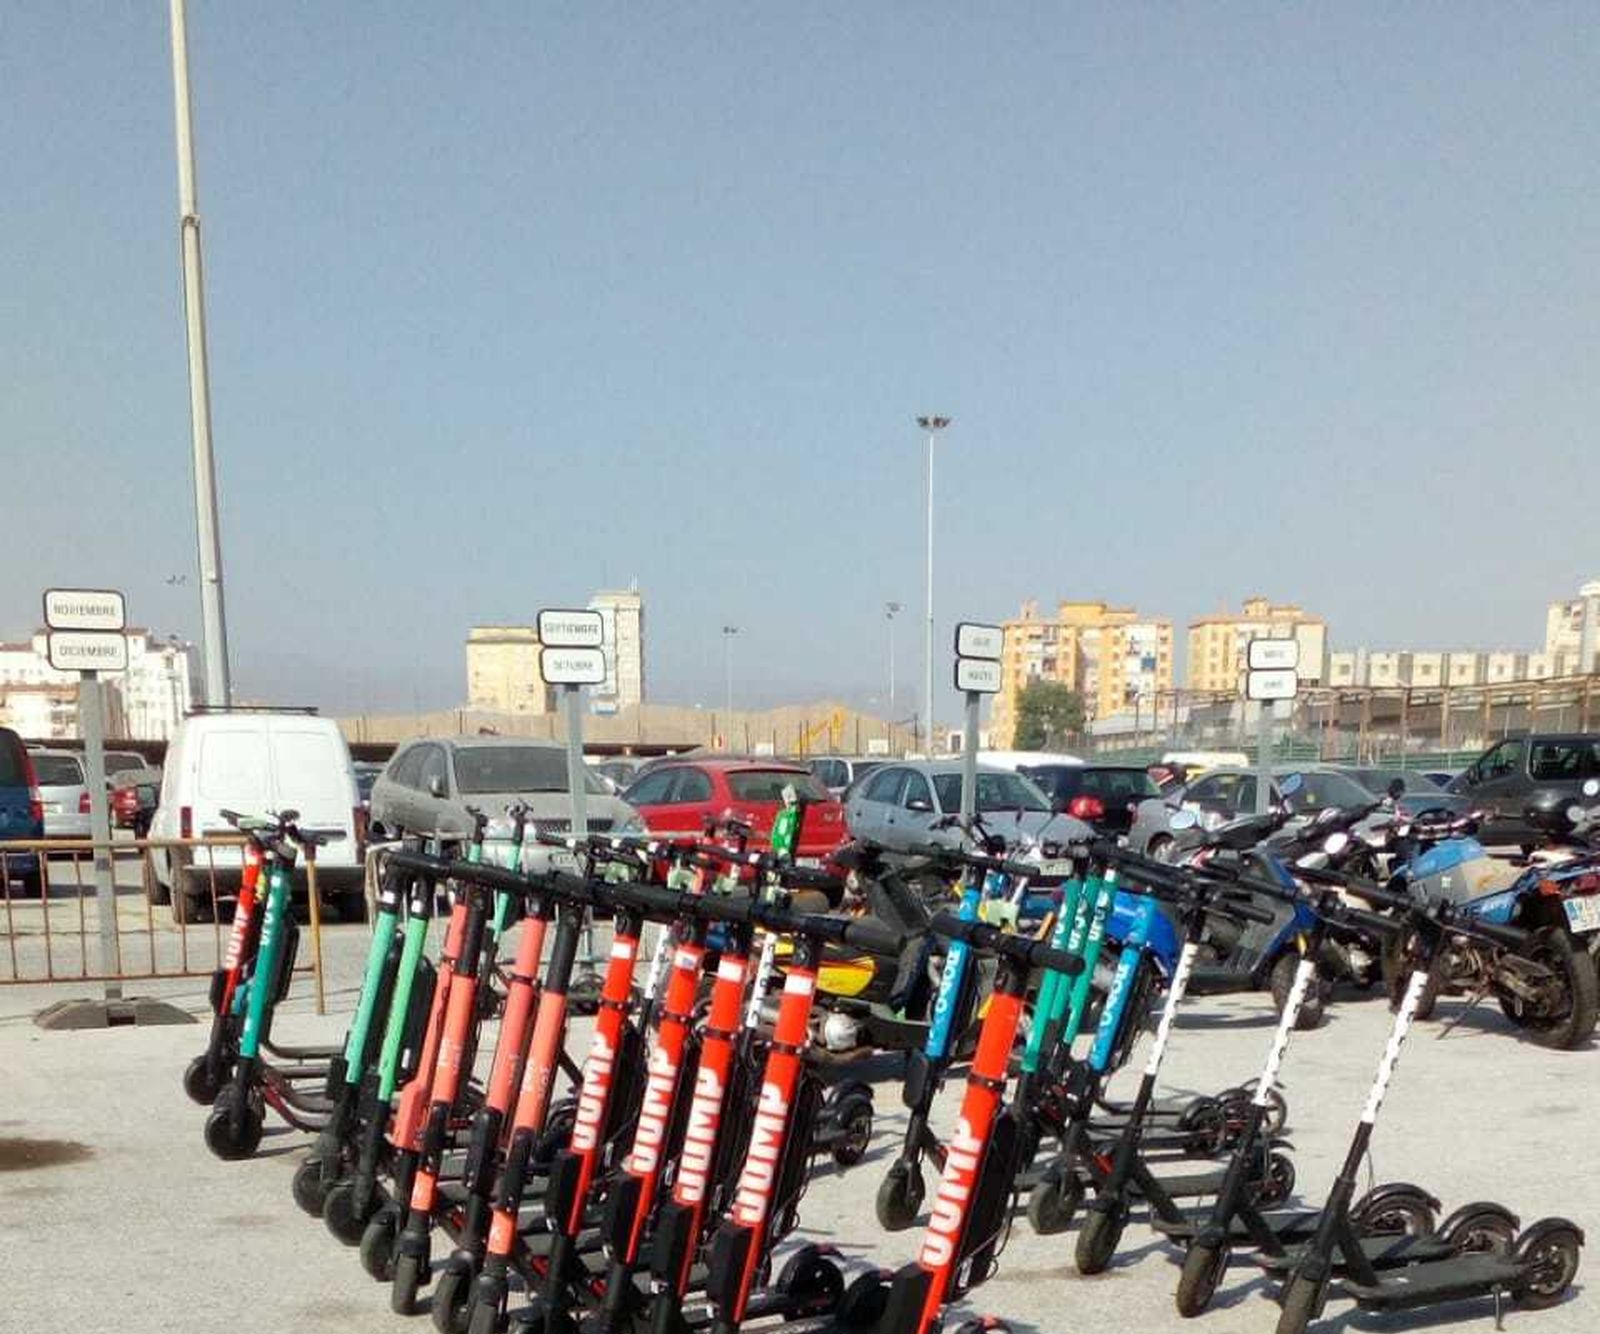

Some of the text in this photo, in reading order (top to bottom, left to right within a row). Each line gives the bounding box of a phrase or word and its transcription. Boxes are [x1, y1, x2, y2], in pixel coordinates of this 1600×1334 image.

[53, 604, 116, 617] NOVIEMBRE
[59, 645, 118, 657] DICIEMBRE
[573, 1030, 616, 1150] JUMP
[631, 1045, 678, 1173] JUMP
[679, 1066, 724, 1202] JUMP
[738, 1081, 789, 1224] JUMP
[920, 1116, 983, 1267] JUMP
